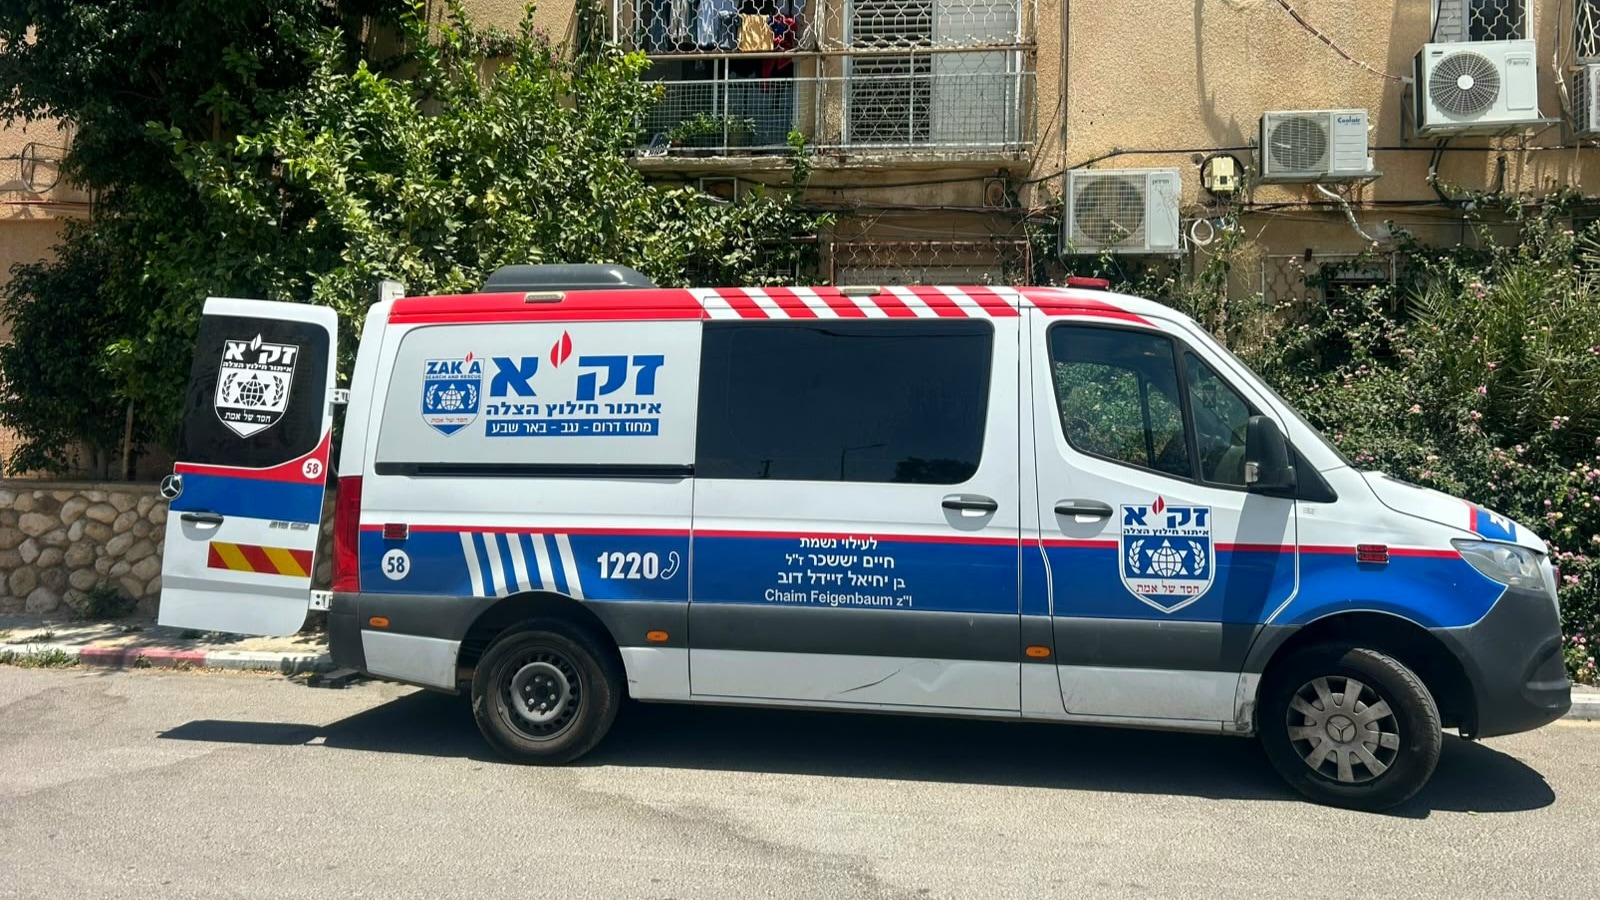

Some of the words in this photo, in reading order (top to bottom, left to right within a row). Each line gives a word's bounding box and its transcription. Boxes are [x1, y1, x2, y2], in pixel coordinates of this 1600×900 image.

[486, 402, 539, 415] הצלה
[546, 401, 598, 417] חילוץ
[604, 402, 662, 414] איתור
[224, 412, 241, 420] אמת
[244, 410, 254, 420] של
[491, 422, 519, 433] שבע
[523, 422, 547, 433] באר
[560, 422, 579, 433] נגב
[592, 422, 621, 433] דרום
[625, 422, 651, 433] מחוז
[305, 463, 319, 475] 58
[1123, 527, 1150, 535] הצלה
[1152, 528, 1179, 536] חילוץ
[800, 537, 837, 549] נשמת
[841, 536, 878, 550] לעילוי
[387, 556, 405, 574] 58
[597, 551, 659, 580] 1220
[808, 554, 858, 567] יששכר
[863, 556, 895, 568] חיים
[778, 572, 803, 585] דוב
[807, 569, 844, 585] זיידל
[847, 571, 888, 587] יחיאל
[893, 577, 906, 591] בן
[1136, 584, 1158, 593] אמת
[1161, 580, 1176, 593] של
[1179, 585, 1200, 593] חסד
[765, 588, 807, 602] Chaim
[811, 590, 893, 607] Feigenbaum
